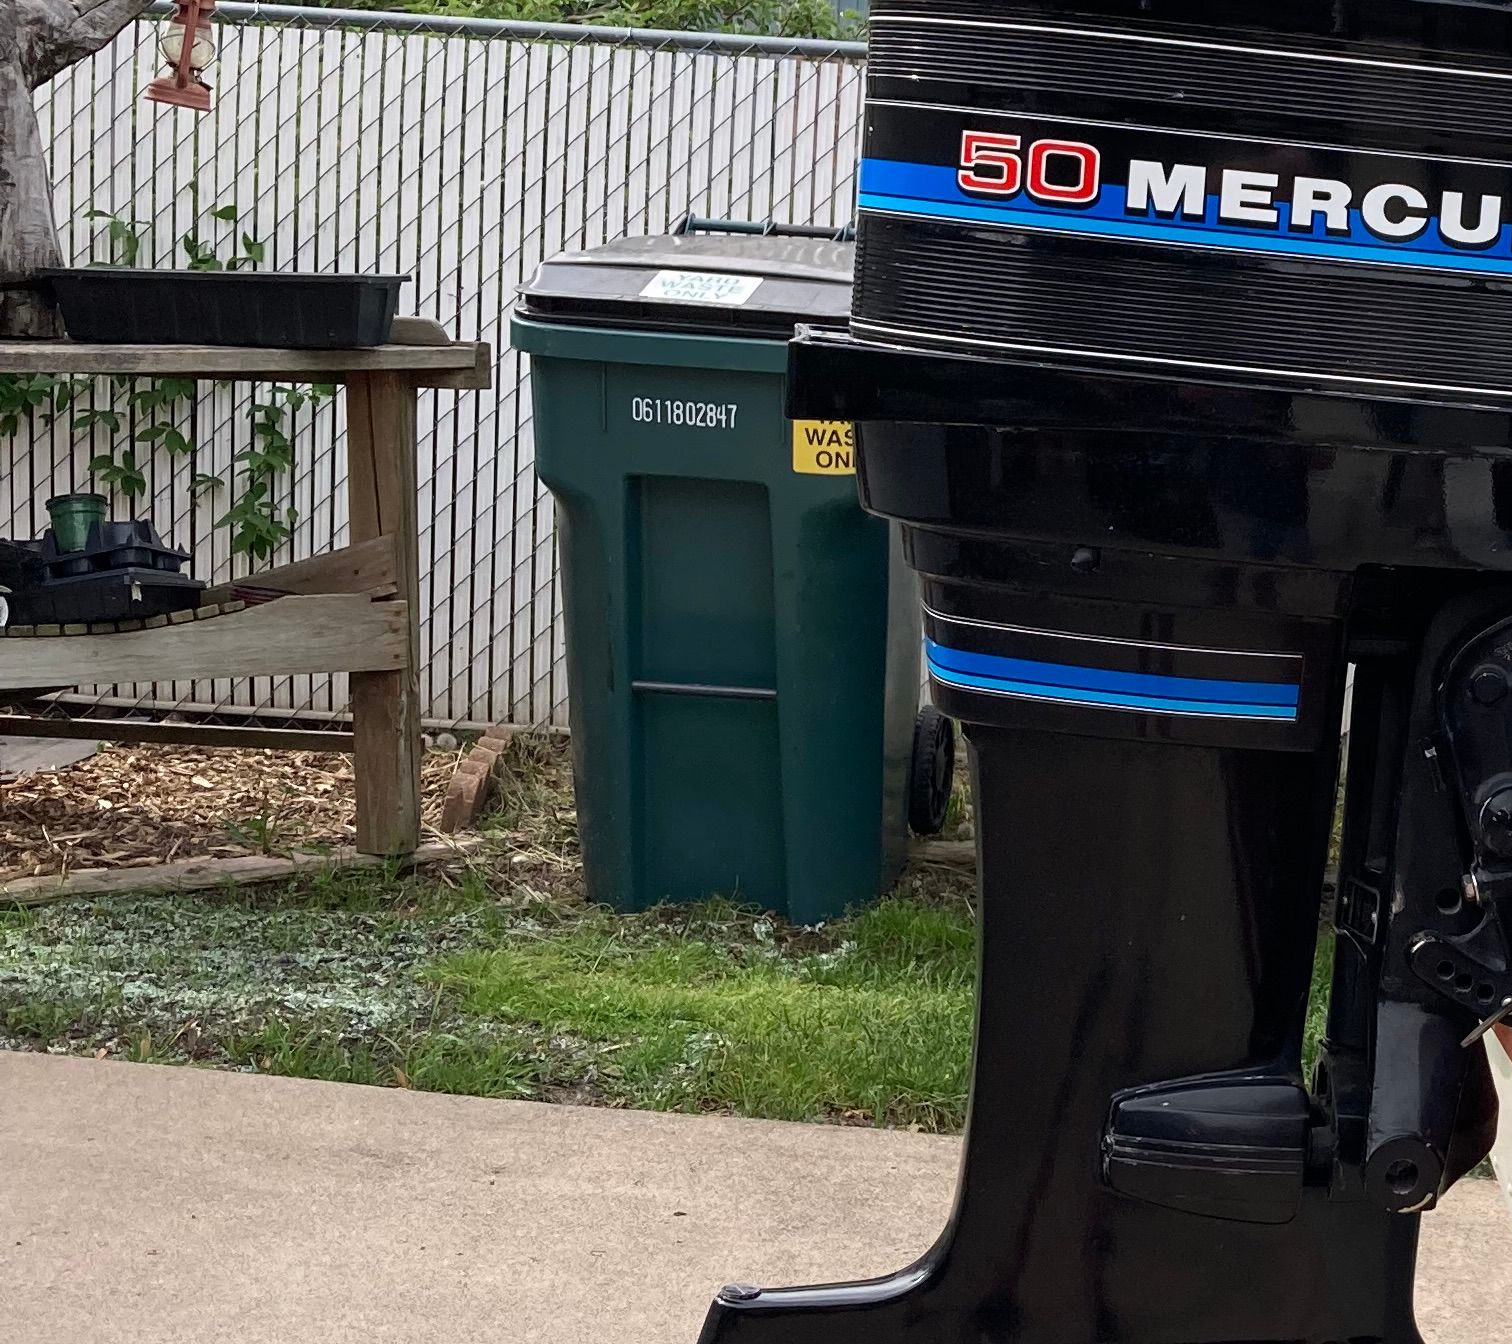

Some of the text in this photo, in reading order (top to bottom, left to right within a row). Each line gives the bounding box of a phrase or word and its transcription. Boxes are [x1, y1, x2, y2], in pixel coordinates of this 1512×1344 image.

[955, 128, 1101, 204] 50
[661, 280, 744, 295] WASTE
[679, 274, 741, 285] YARD
[663, 289, 729, 300] ONLY
[632, 397, 738, 429] 0611802847
[816, 451, 855, 469] ON
